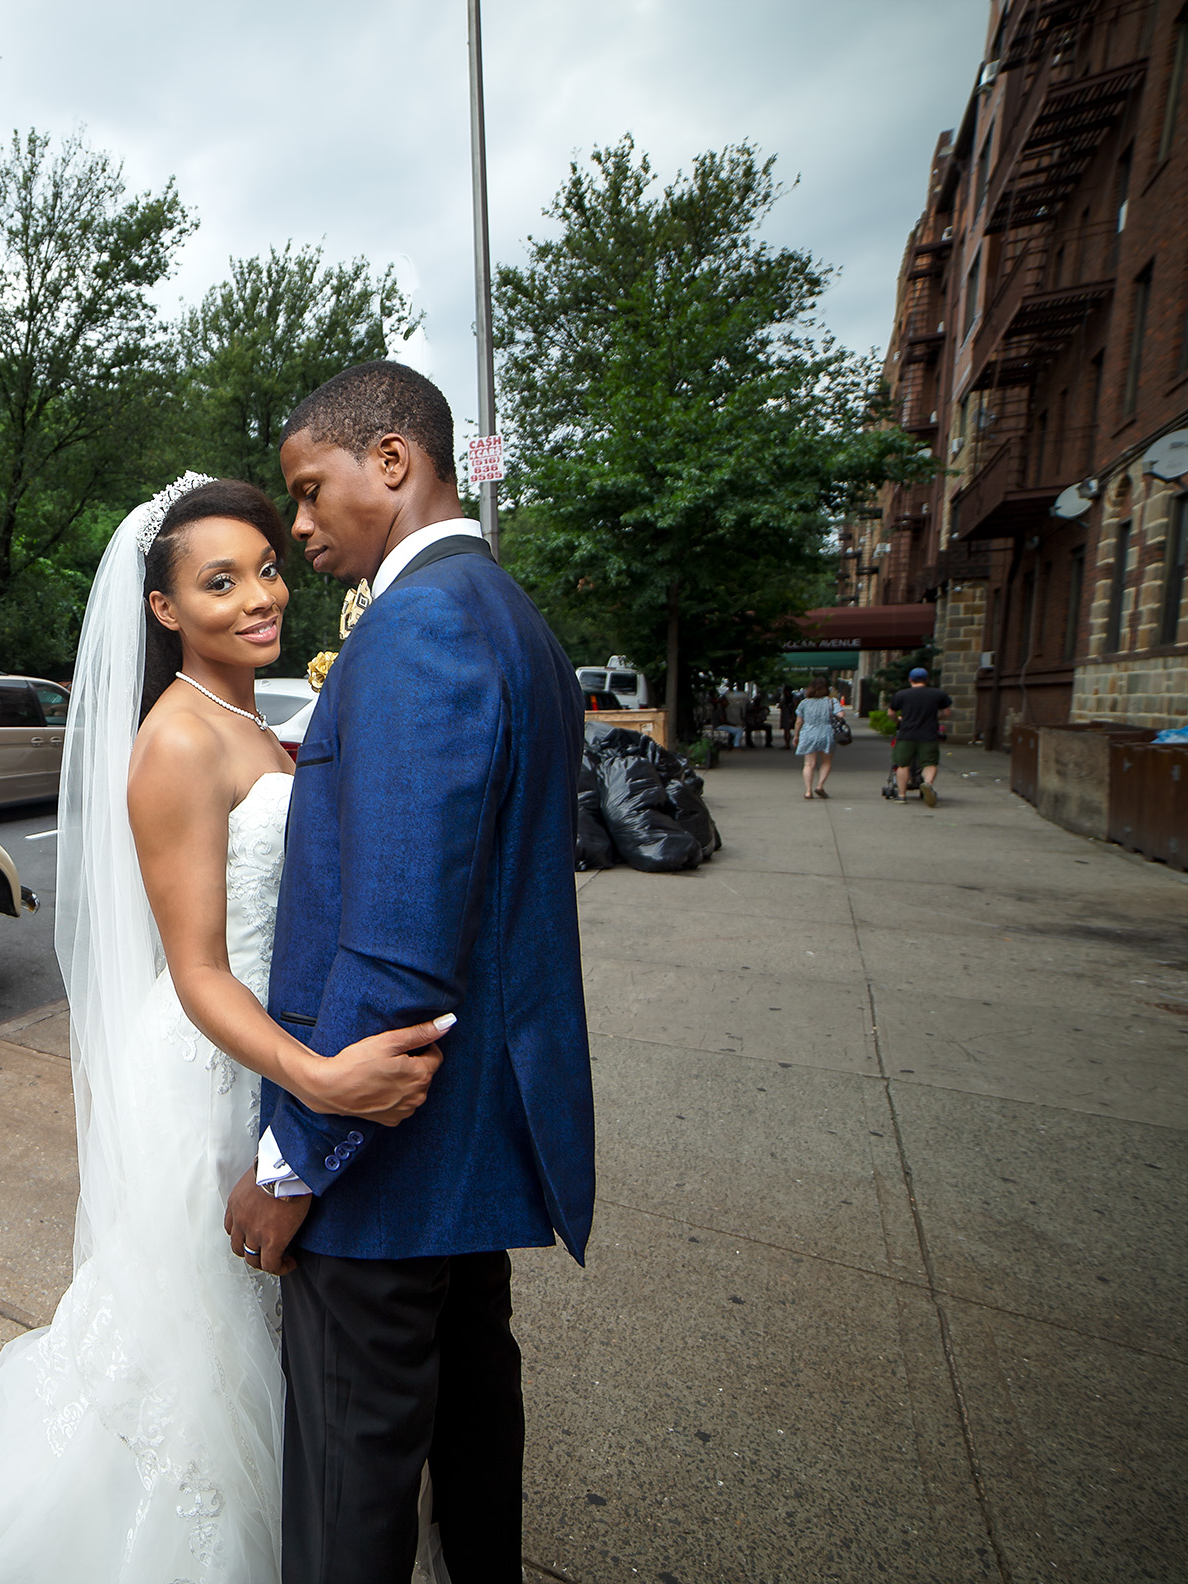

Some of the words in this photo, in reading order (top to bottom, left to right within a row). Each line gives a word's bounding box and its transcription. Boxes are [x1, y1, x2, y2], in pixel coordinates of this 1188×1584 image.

[474, 464, 498, 474] 636
[470, 471, 502, 482] 9595
[819, 638, 861, 649] AVENUE
